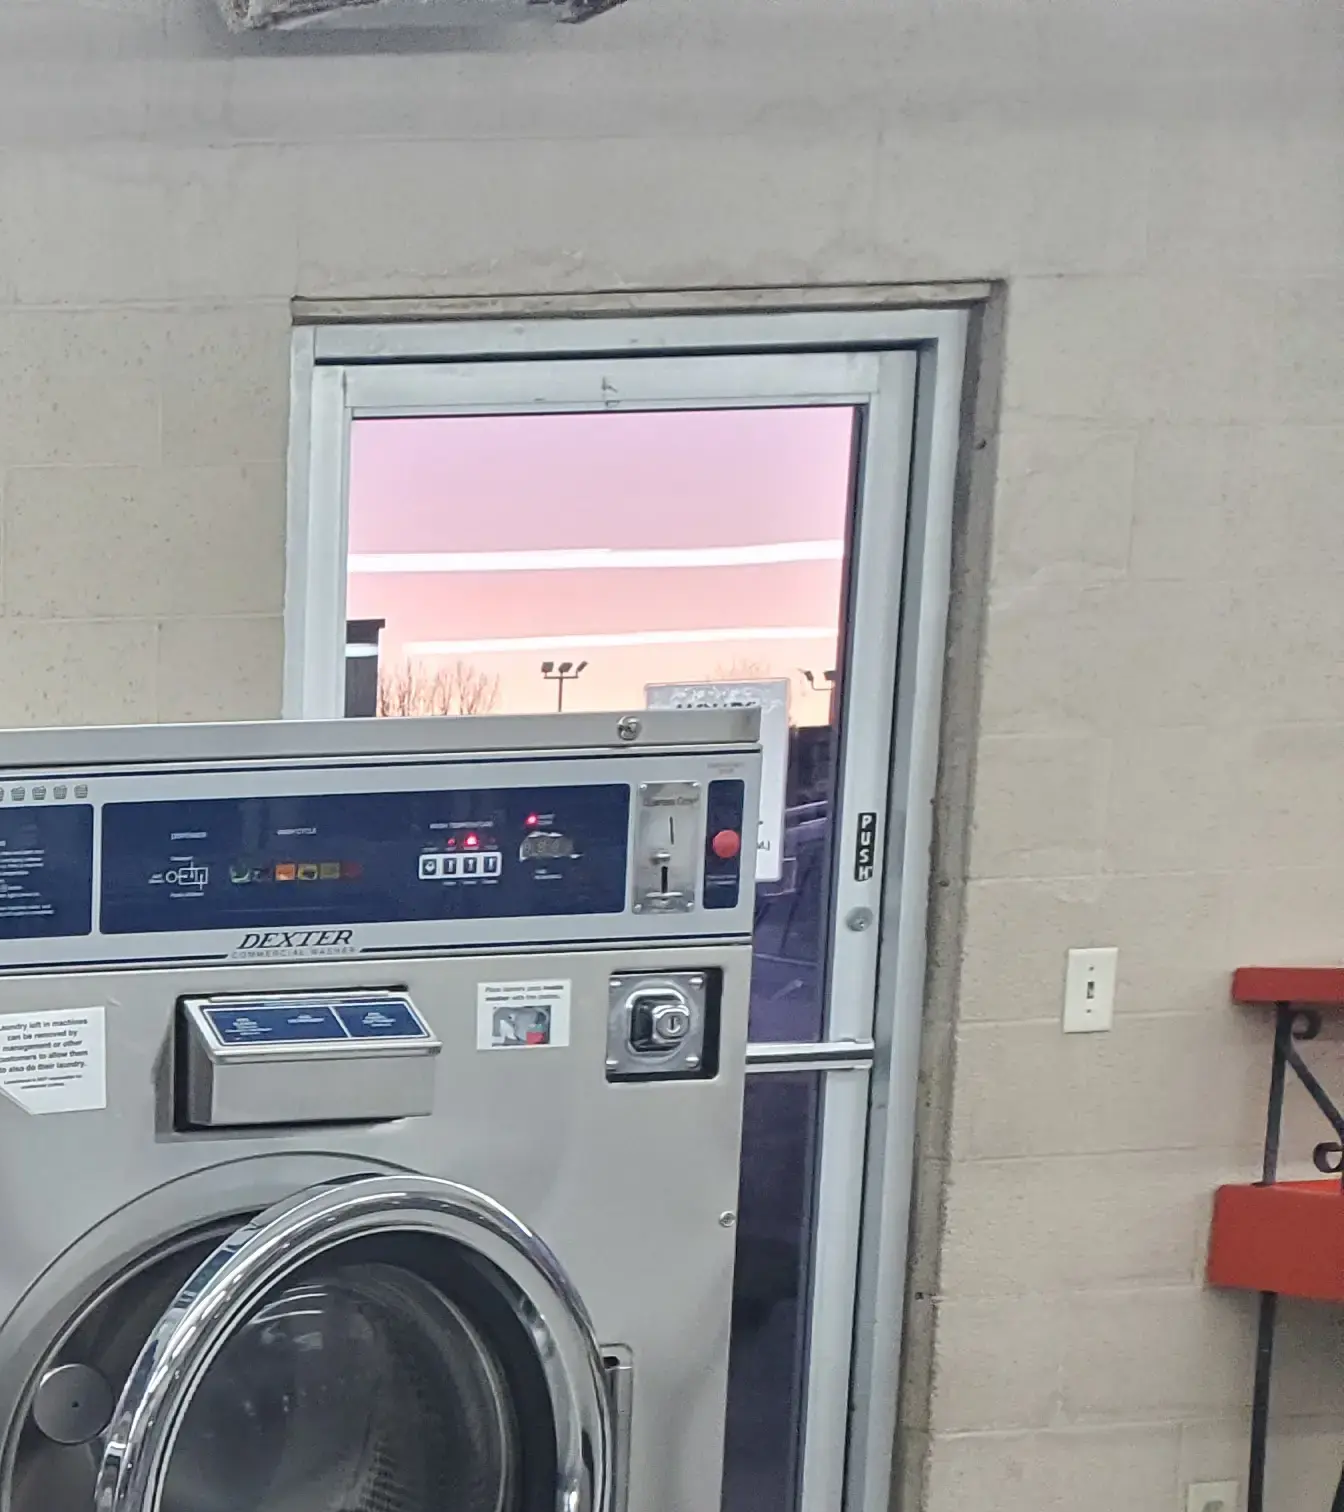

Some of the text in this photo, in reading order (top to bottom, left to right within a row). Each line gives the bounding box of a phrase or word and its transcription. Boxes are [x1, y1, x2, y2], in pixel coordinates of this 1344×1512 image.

[859, 814, 872, 880] PUSH
[236, 930, 353, 949] DEXTER
[231, 947, 355, 959] COMMERCIAL WASHER
